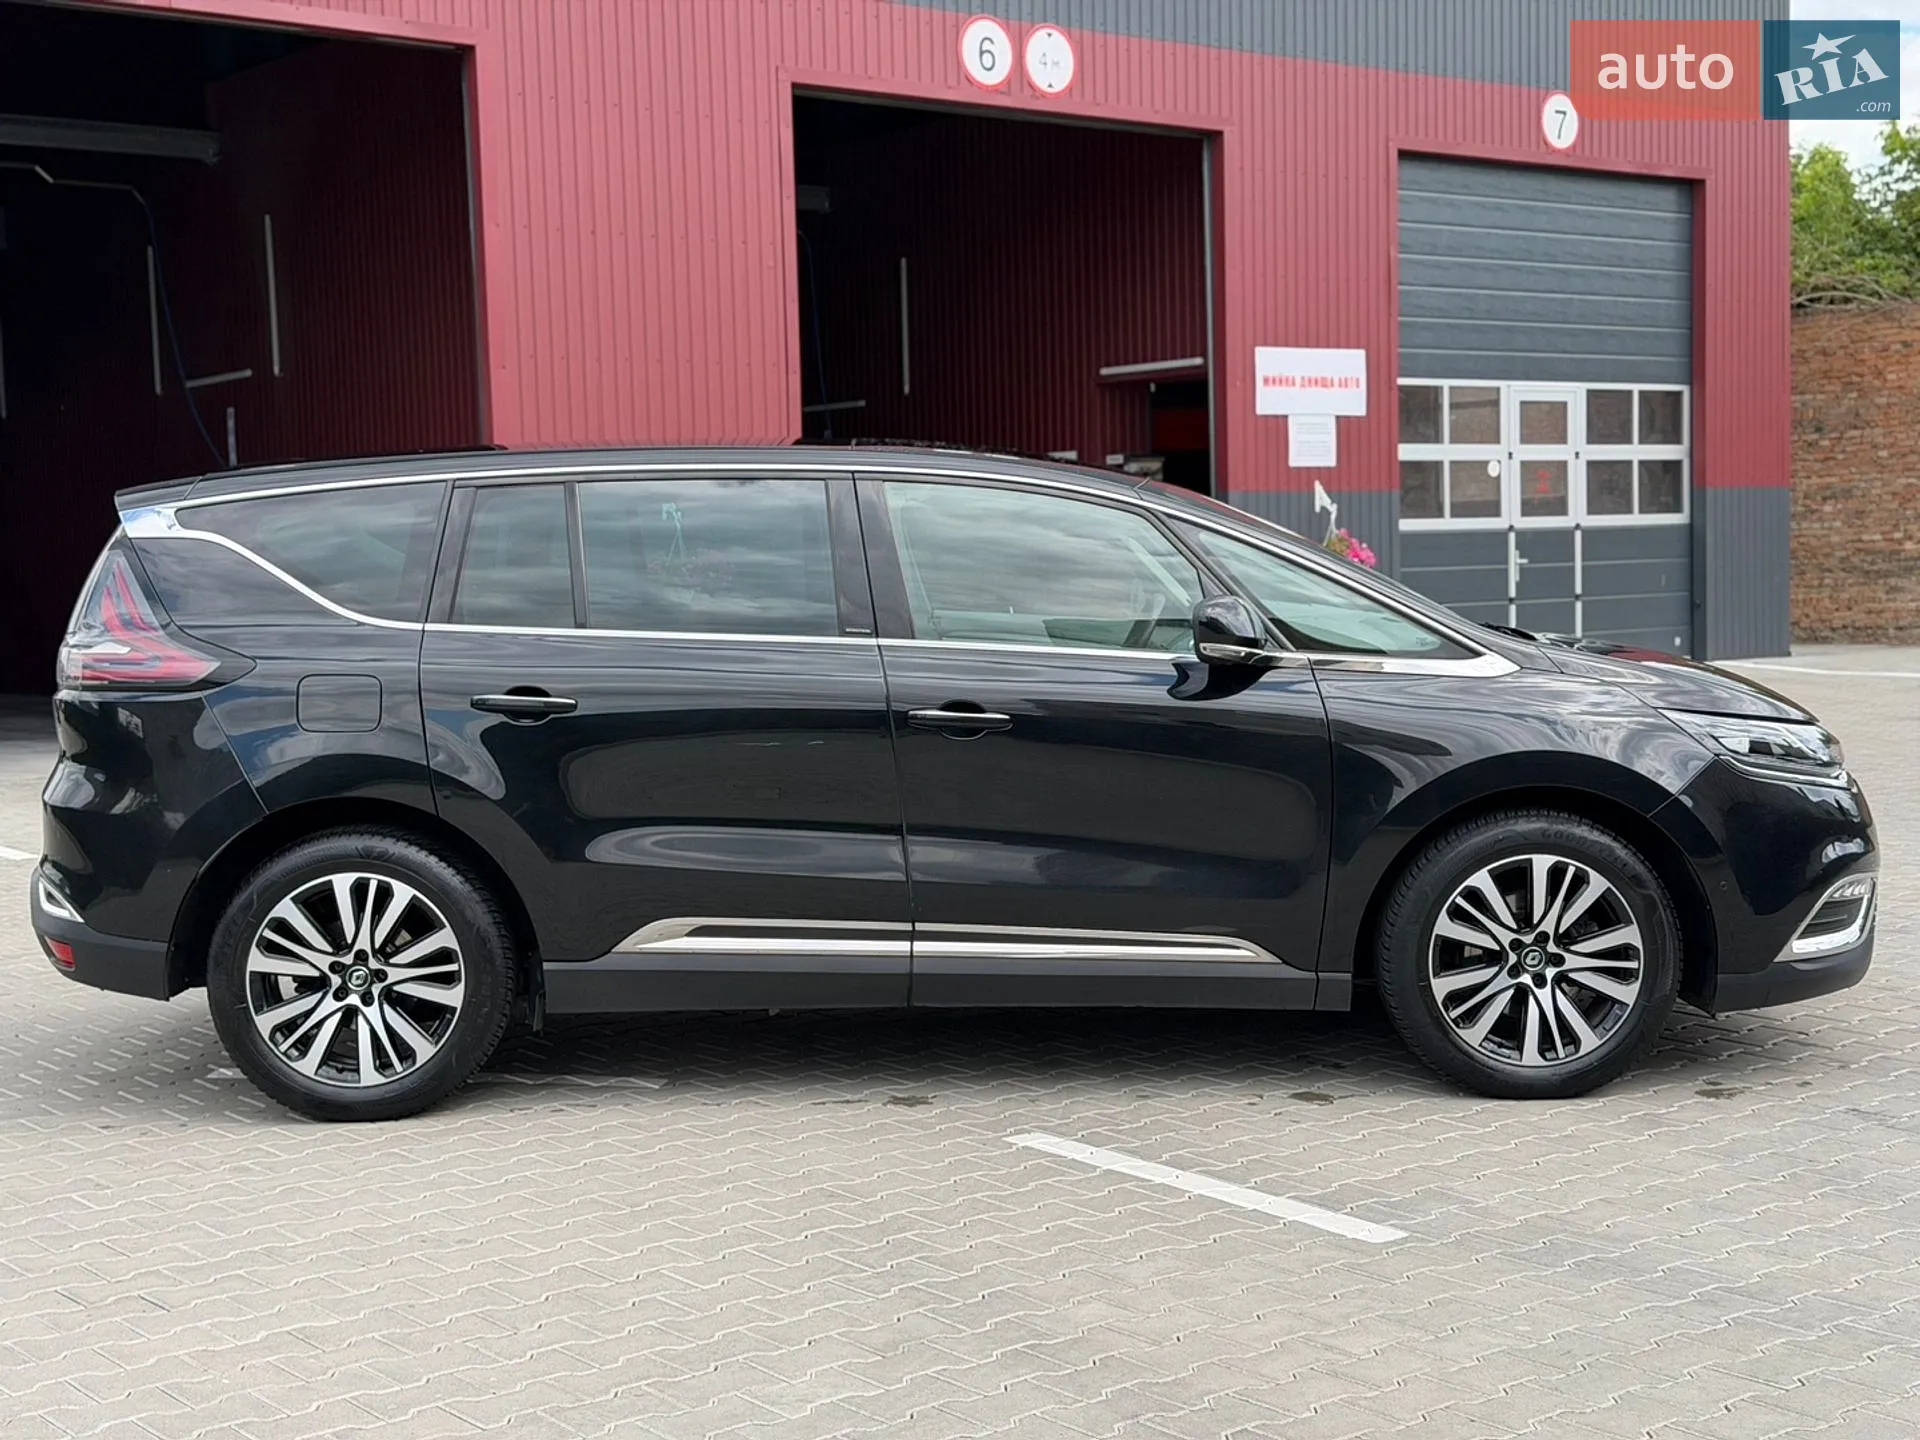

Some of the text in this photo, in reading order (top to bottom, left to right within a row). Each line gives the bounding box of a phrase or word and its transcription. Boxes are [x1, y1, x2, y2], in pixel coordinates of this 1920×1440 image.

[979, 36, 995, 72] 6
[1039, 51, 1048, 69] 4
[1554, 109, 1567, 140] 7
